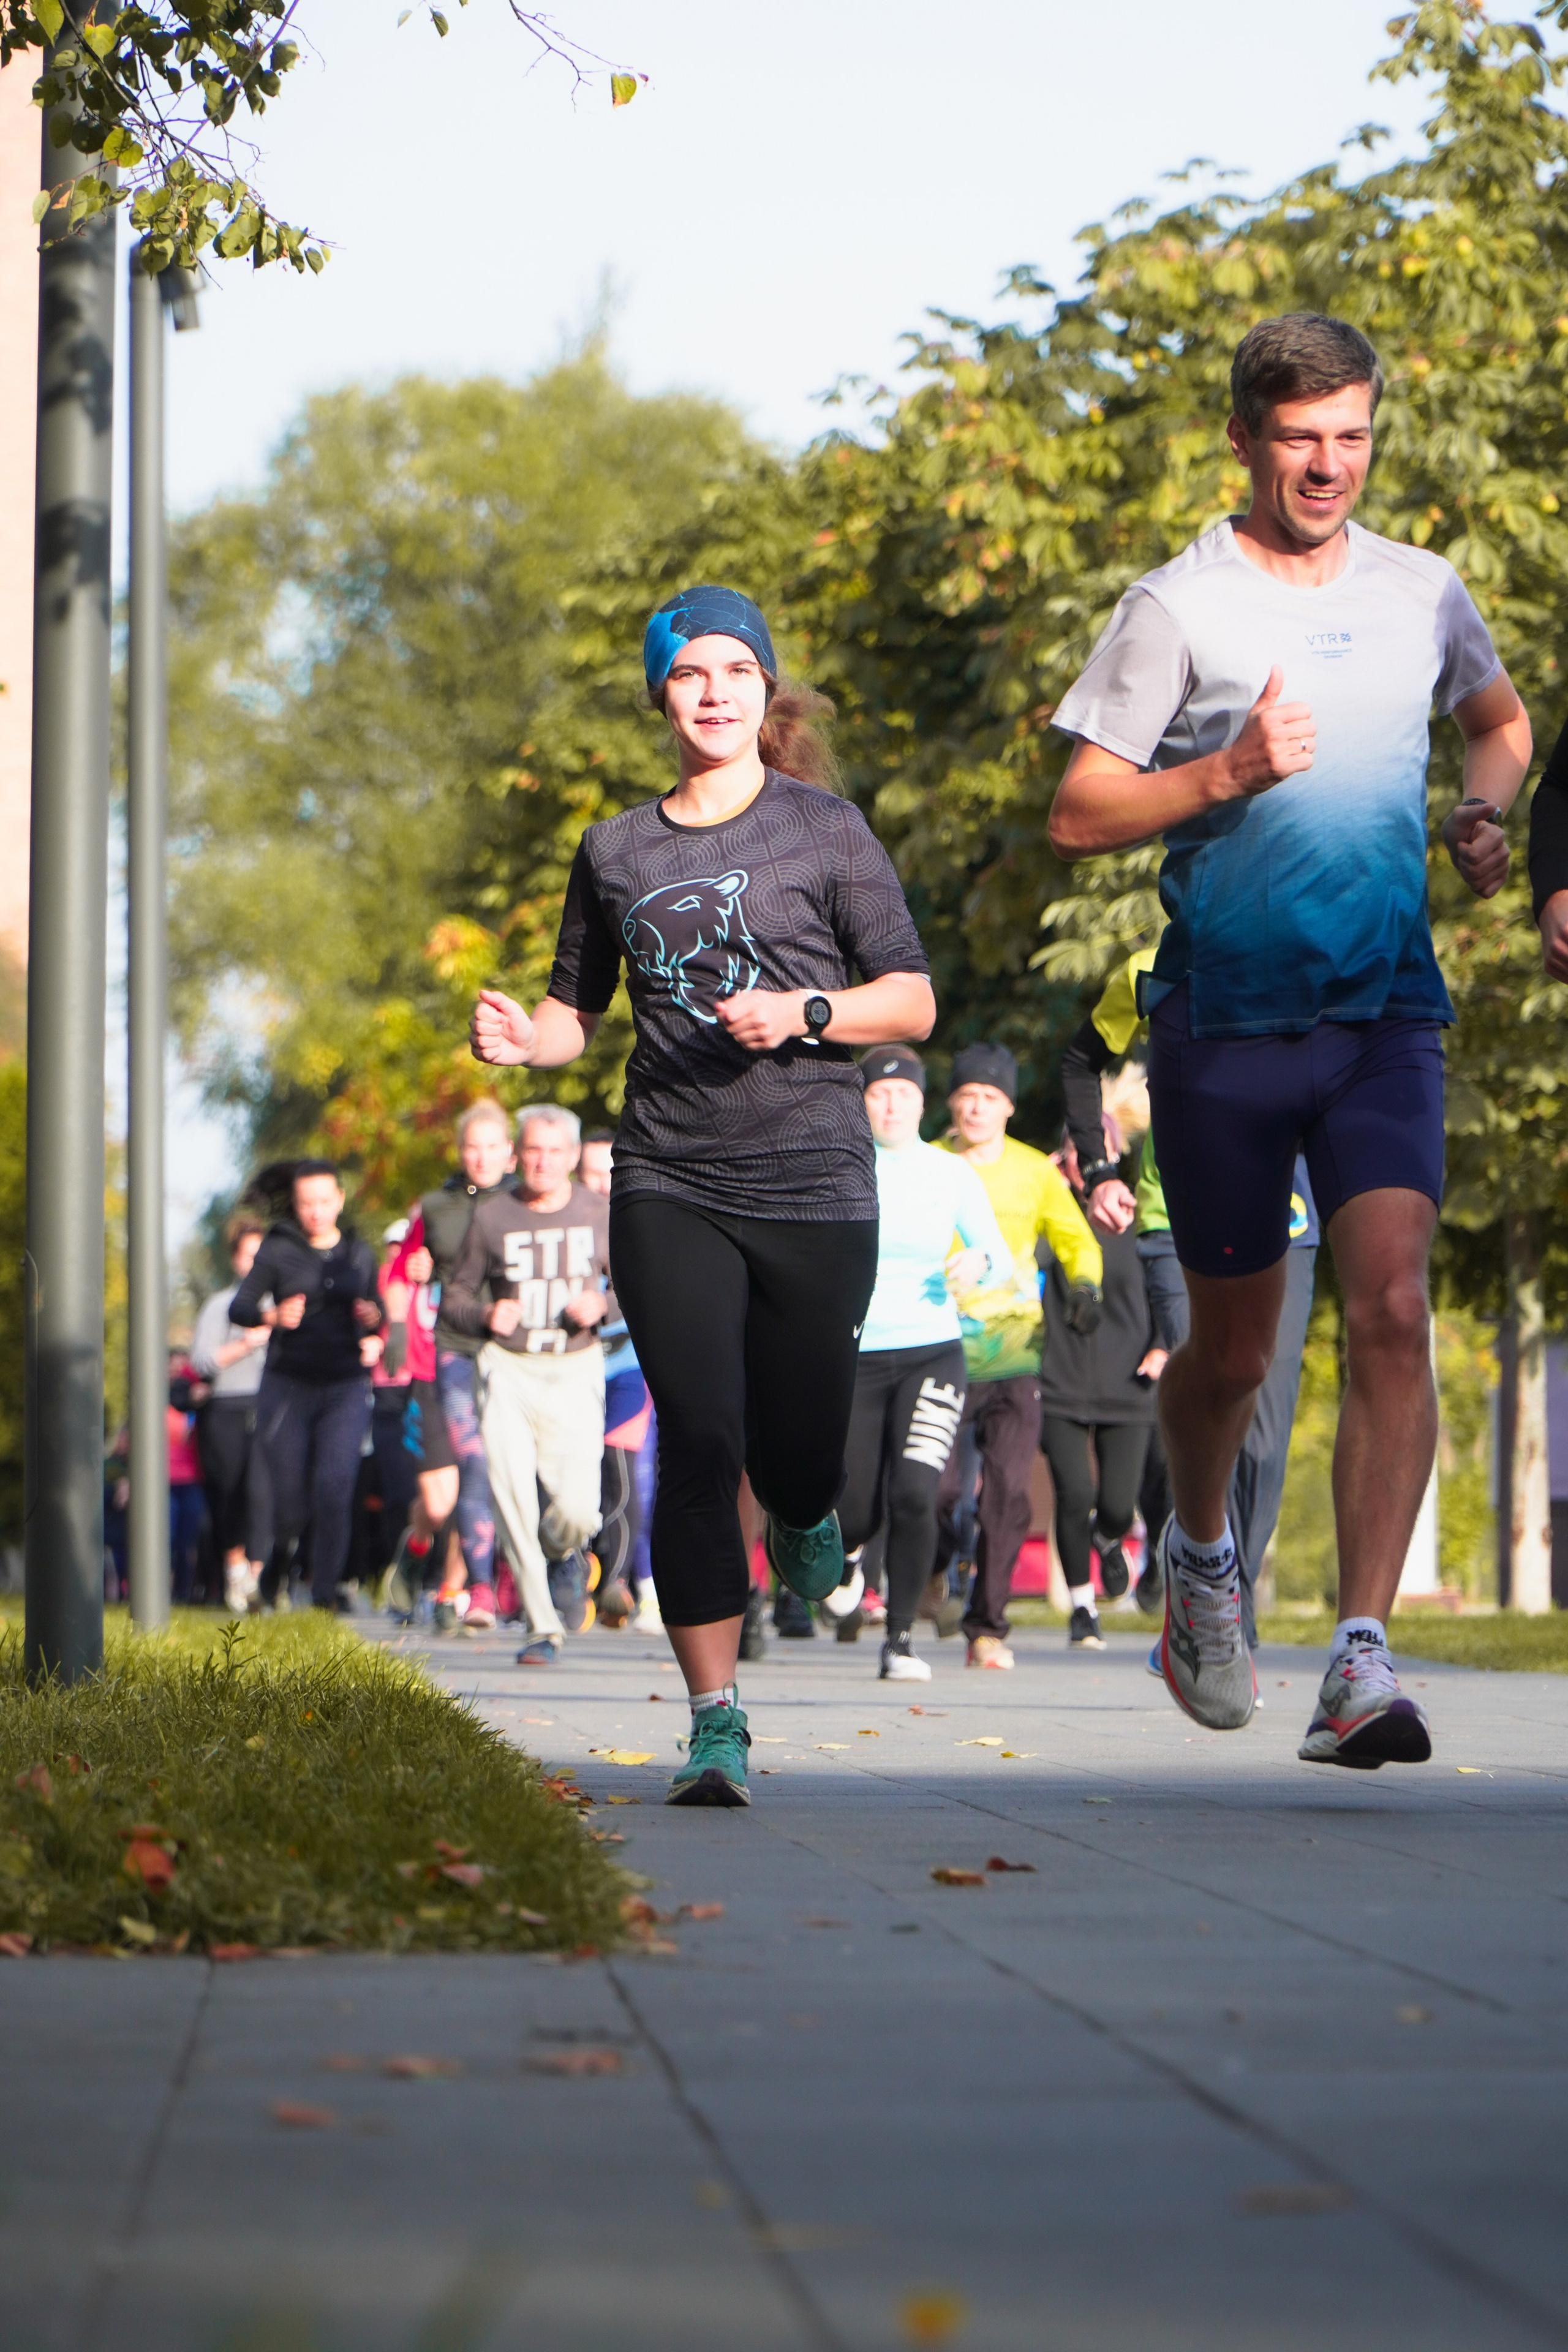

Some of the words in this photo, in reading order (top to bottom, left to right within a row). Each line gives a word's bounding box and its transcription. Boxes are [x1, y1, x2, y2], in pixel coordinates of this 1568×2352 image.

[1305, 633, 1338, 646] VTR
[503, 1226, 594, 1282] STR
[902, 1377, 966, 1474] NIKE
